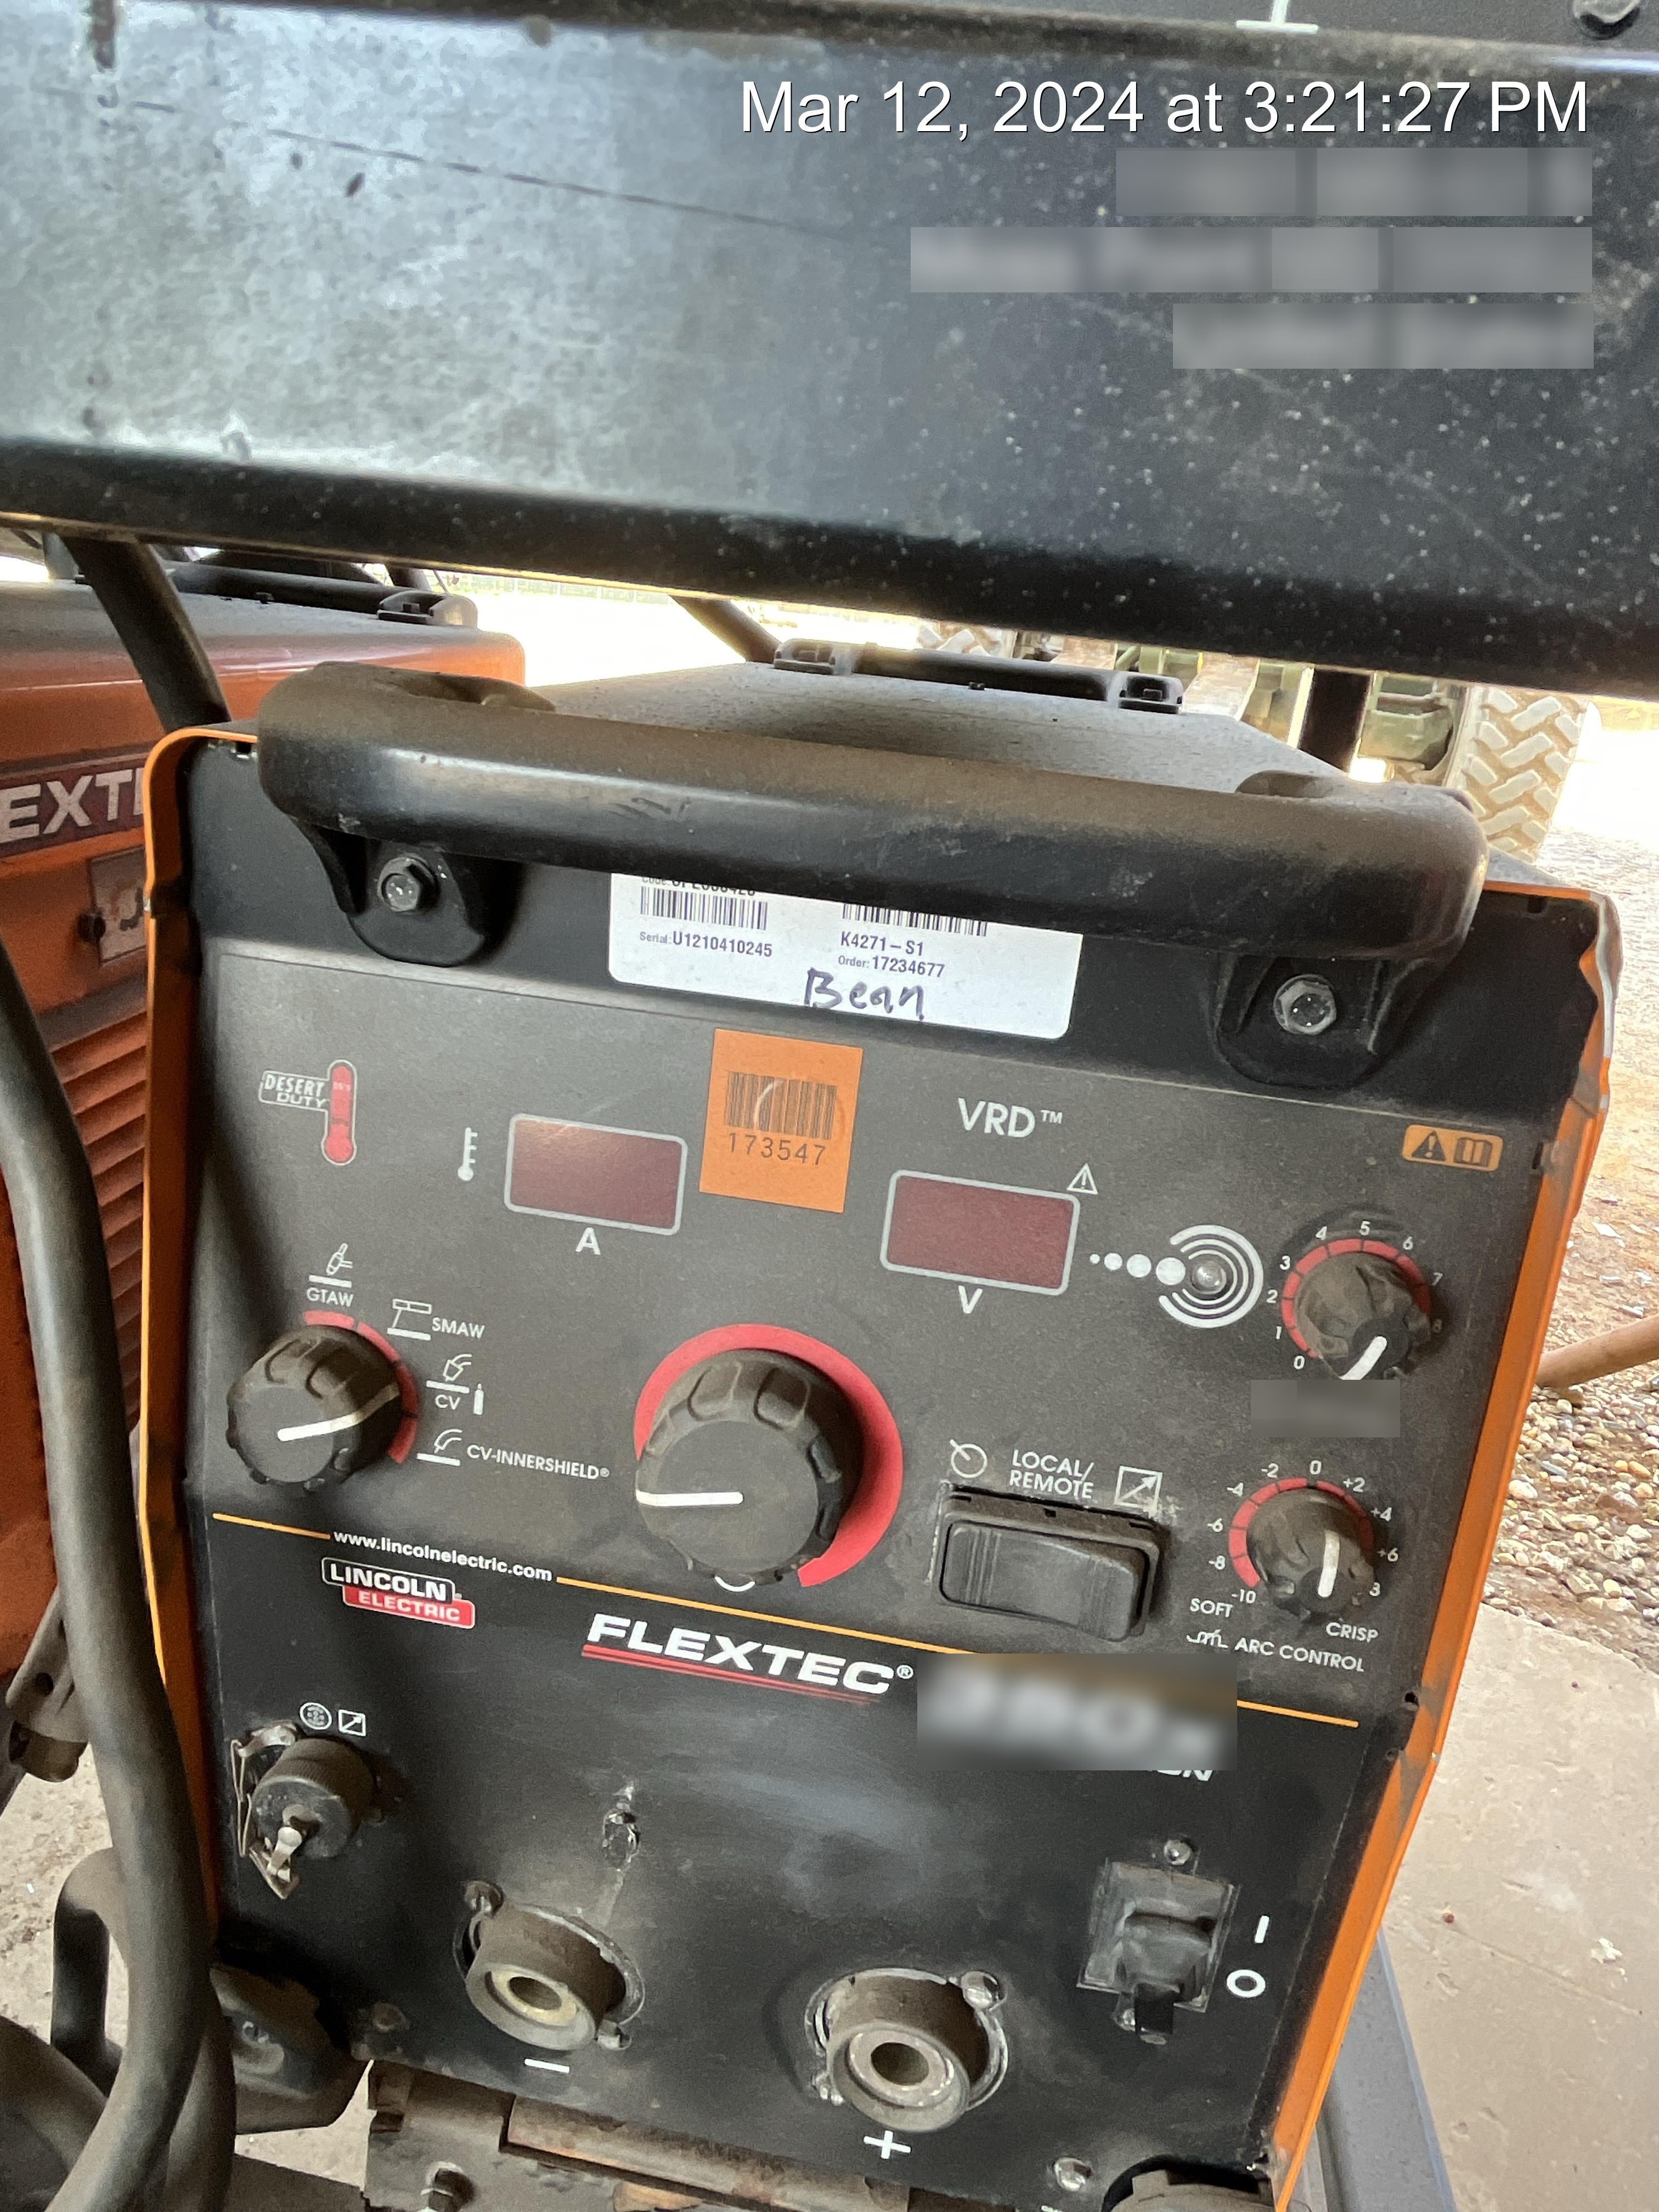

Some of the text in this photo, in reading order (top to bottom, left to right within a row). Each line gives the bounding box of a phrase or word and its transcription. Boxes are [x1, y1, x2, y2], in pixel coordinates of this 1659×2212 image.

[264, 1074, 325, 1097] DESERT
[276, 1092, 326, 1108] DUTY
[729, 1132, 827, 1166] 173547
[1316, 1226, 1328, 1241] 4
[1359, 1221, 1371, 1236] 5
[575, 1227, 601, 1256] A
[1402, 1236, 1413, 1251] 6
[1279, 1255, 1291, 1270] 3
[1431, 1272, 1443, 1286] 7
[306, 1287, 354, 1307] GTAW
[957, 1285, 983, 1314] V
[1266, 1290, 1278, 1304] 2
[431, 1317, 485, 1339] SMAW
[1275, 1326, 1282, 1340] 1
[1294, 1355, 1305, 1370] 0
[435, 1394, 461, 1410] CV
[1012, 1449, 1094, 1480] LOCAL/
[1261, 1463, 1279, 1479] -2
[1309, 1460, 1322, 1475] 0
[1009, 1470, 1093, 1499] REMOTE
[1227, 1482, 1244, 1497] -4
[1343, 1477, 1365, 1493] +2
[1207, 1517, 1223, 1533] -6
[334, 1531, 553, 1582] www.lincolnelectric.com
[330, 1562, 447, 1602] LINCOLN
[1231, 1589, 1257, 1604] -10
[358, 1590, 461, 1623] ELECTRIC
[1189, 1598, 1234, 1618] SOFT
[1325, 1621, 1379, 1643] CRISP
[1234, 1637, 1365, 1673] ARC CONTROL
